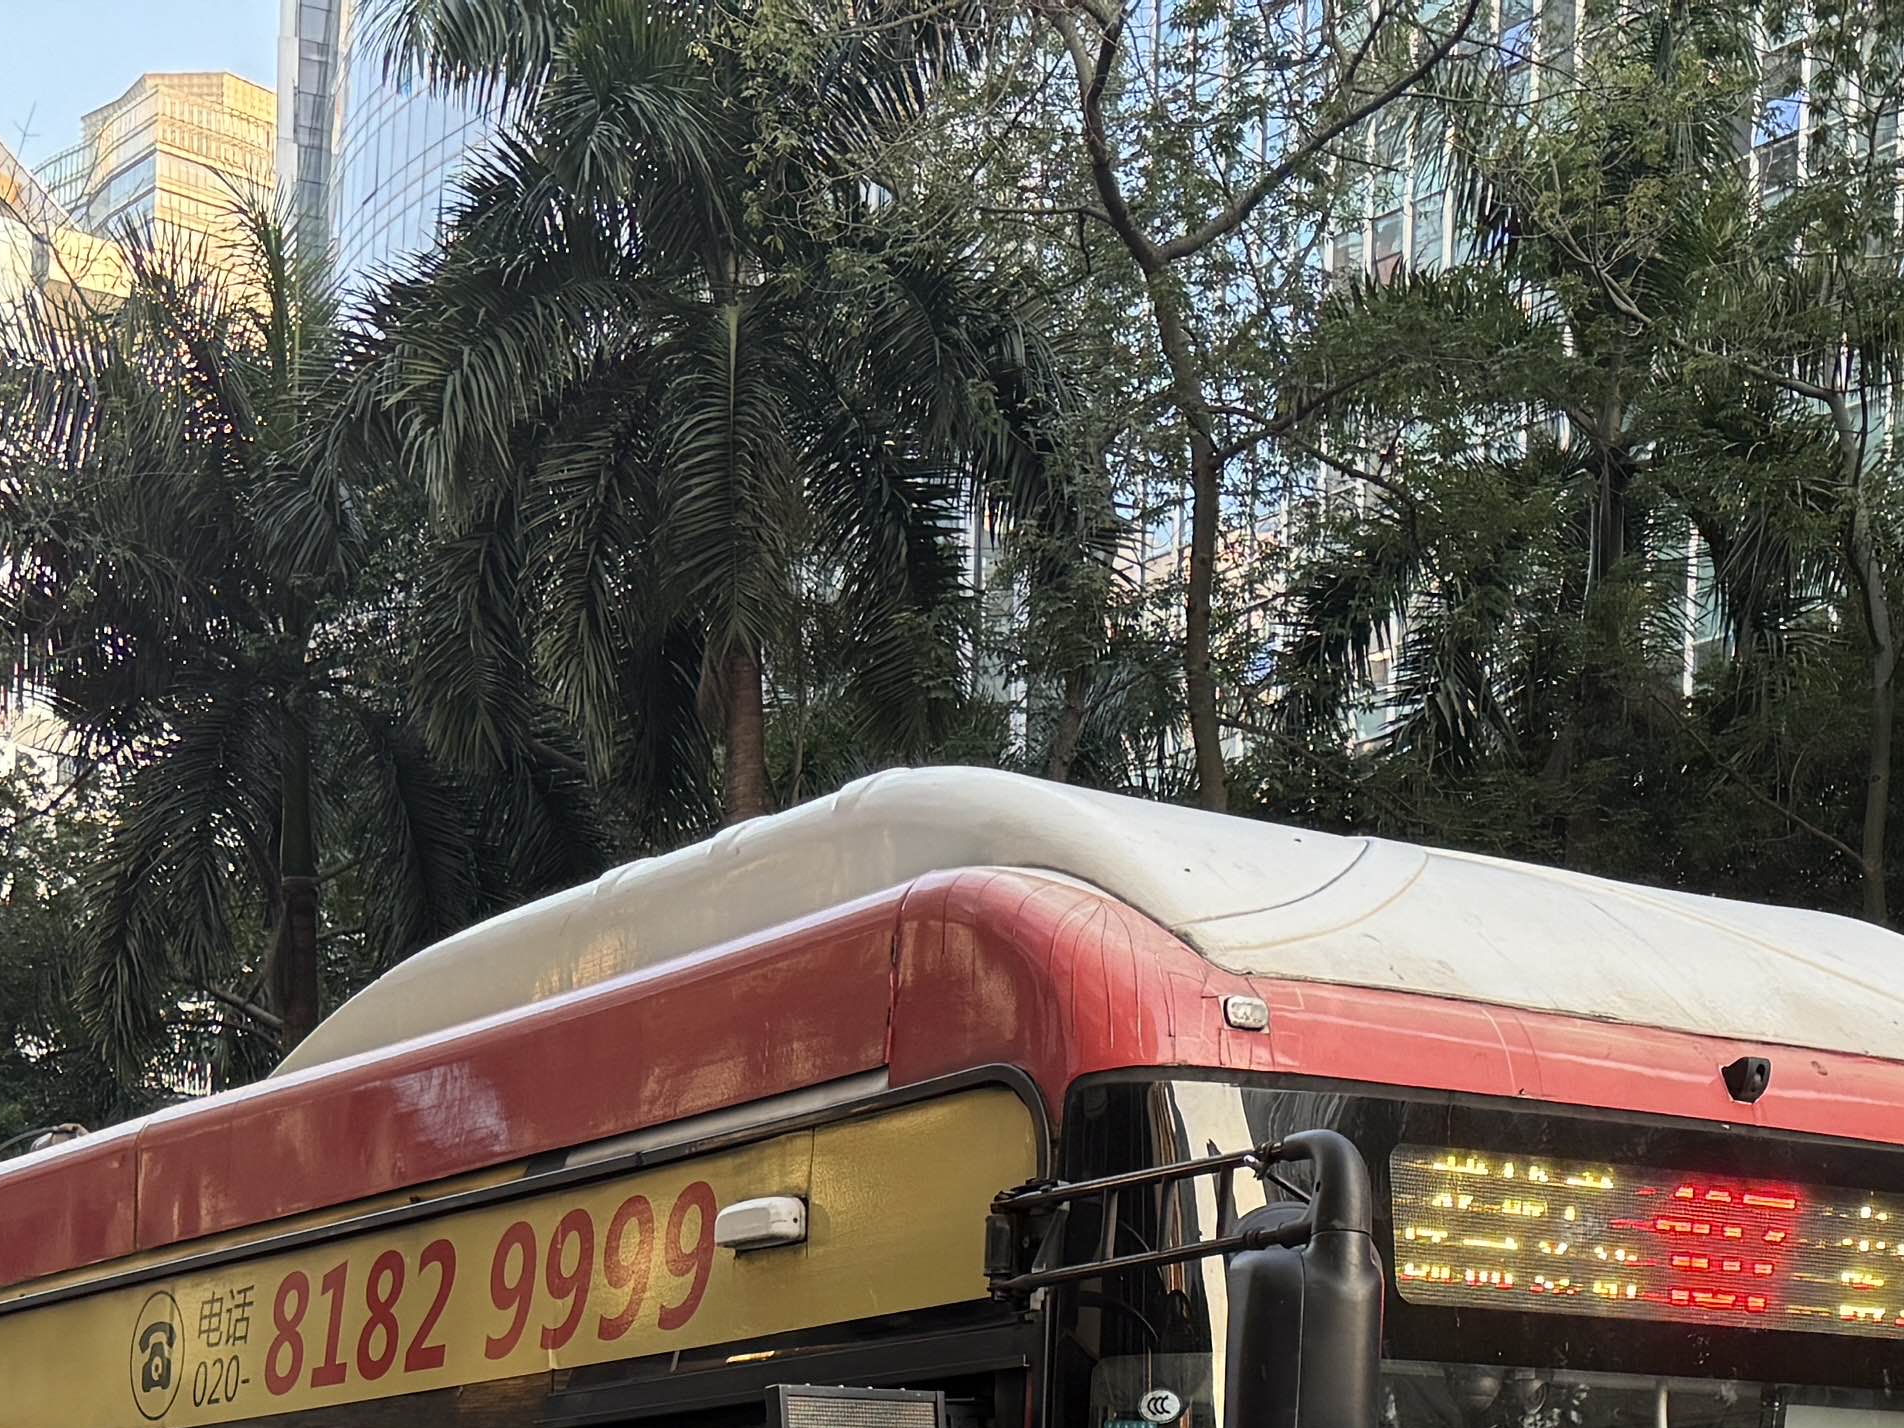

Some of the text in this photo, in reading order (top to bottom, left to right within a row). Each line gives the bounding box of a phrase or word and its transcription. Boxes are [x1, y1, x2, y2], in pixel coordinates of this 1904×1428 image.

[192, 1181, 718, 1408] 020- 8182 9999
[198, 1285, 254, 1347] 电话
